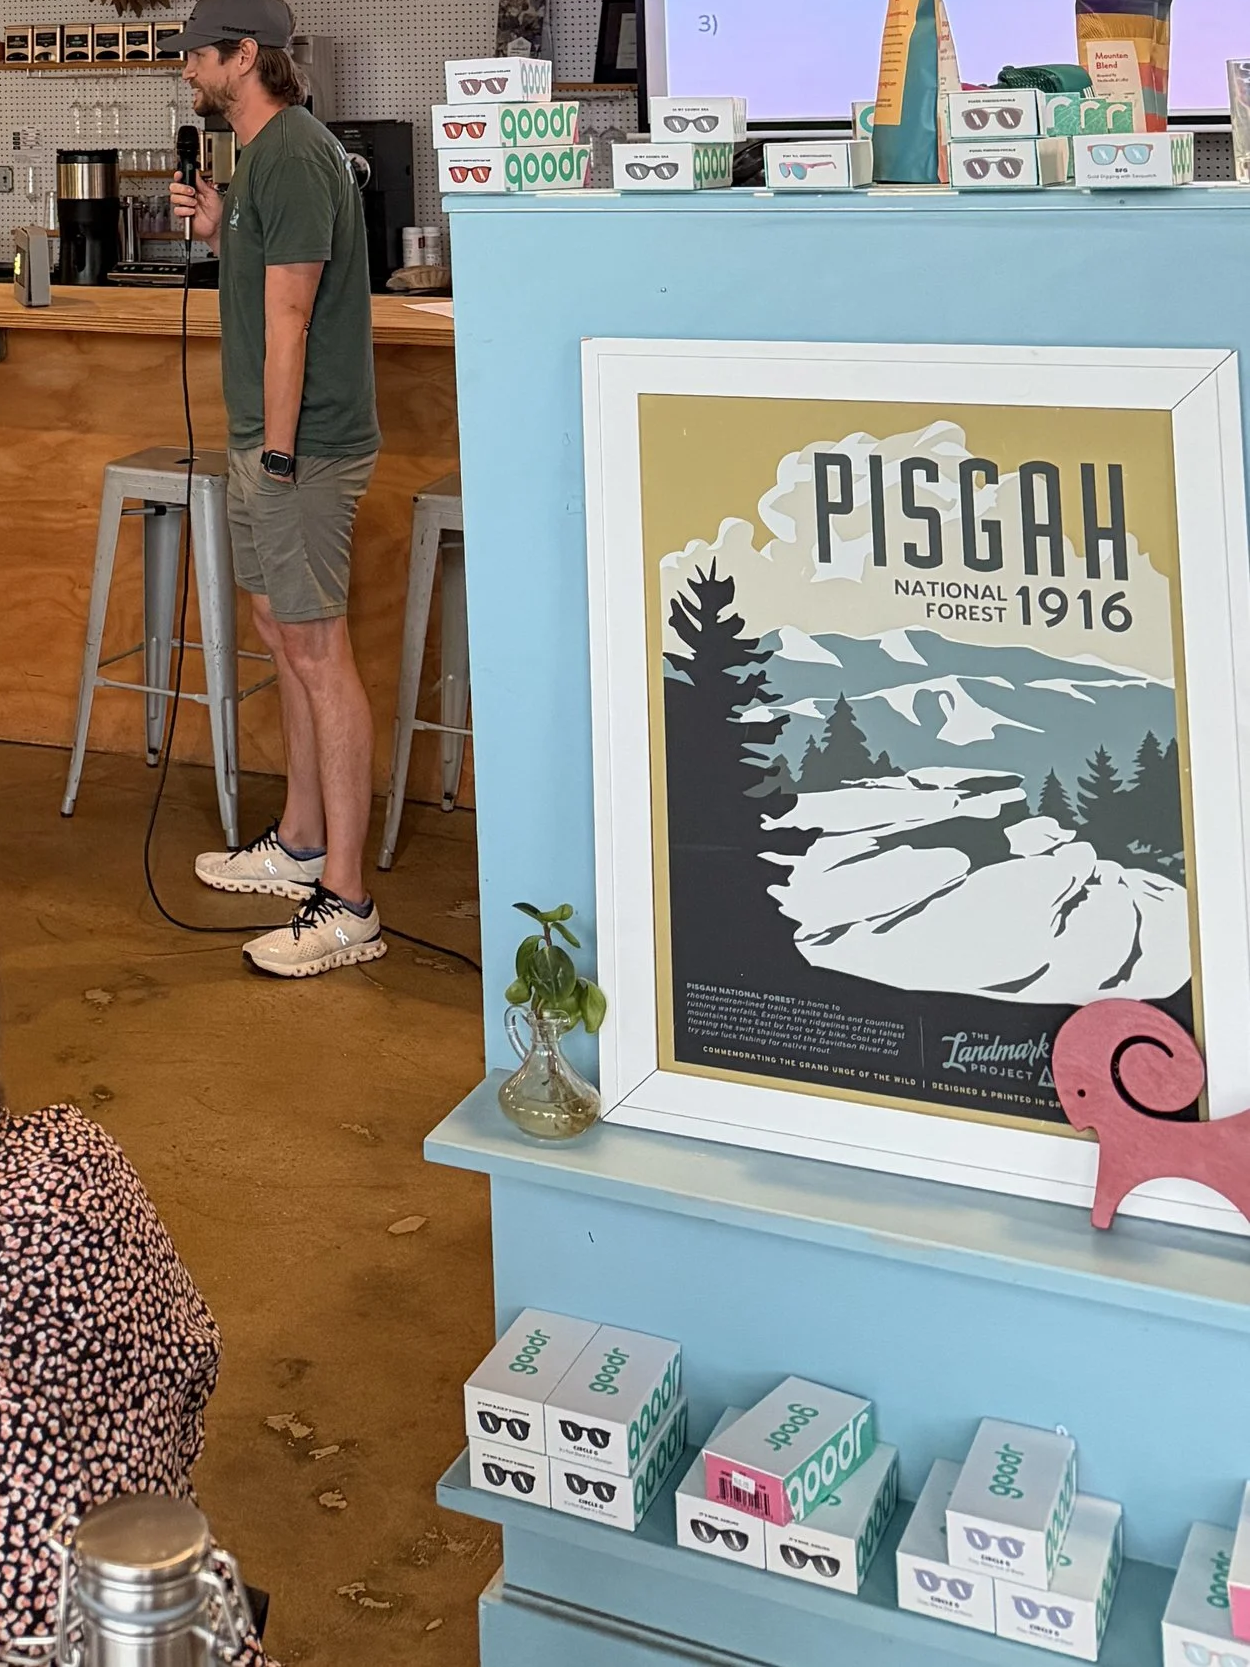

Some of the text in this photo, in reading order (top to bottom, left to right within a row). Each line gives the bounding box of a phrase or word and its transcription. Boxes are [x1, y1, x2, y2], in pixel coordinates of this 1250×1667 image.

[698, 13, 719, 36] 3)
[1095, 61, 1119, 70] Blend
[500, 103, 578, 147] goodr
[504, 147, 589, 191] goodr
[814, 452, 1130, 582] PISGAH
[894, 579, 1008, 602] NATIONAL
[926, 584, 1133, 634] FOREST 1916
[687, 982, 829, 1010] PISGAH NATIONAL FOREST home
[687, 1001, 716, 1012] rushing
[761, 1011, 792, 1022] Explore
[794, 1016, 807, 1024] the
[810, 1018, 850, 1031] ridgelines
[863, 1024, 877, 1034] the
[879, 1029, 905, 1040] tallest
[687, 1010, 728, 1021] mountains
[739, 1017, 752, 1025] the
[754, 1018, 772, 1027] East
[786, 1023, 803, 1032] foot
[851, 1034, 870, 1043] Cool
[872, 1036, 885, 1045] off
[688, 1017, 900, 1056] floating the swift shallows the Davidson River and
[792, 1008, 821, 1018] granite
[823, 1011, 846, 1022] balds
[848, 1016, 863, 1024] and
[865, 1018, 905, 1030] countless
[972, 1031, 989, 1040] THE
[720, 1031, 737, 1039] luck
[739, 1033, 767, 1045] fishing
[783, 1040, 807, 1051] native
[941, 1031, 1050, 1073] Landmark
[703, 1045, 777, 1064] COMMEMORATING
[779, 1057, 797, 1067] THE
[799, 1061, 829, 1072] GRAND
[832, 1066, 855, 1077] URGE
[859, 1070, 871, 1079] OF
[874, 1072, 890, 1082] THE
[894, 1076, 916, 1086] WILD
[932, 1082, 978, 1095] DESIGNED
[990, 1091, 1031, 1104] PRINTED
[971, 1063, 1033, 1081] PROJECT
[509, 1329, 551, 1375] goodr
[588, 1347, 630, 1395] goodr
[628, 1352, 681, 1464] goodr
[765, 1403, 819, 1451] goodr
[784, 1412, 869, 1522] goodr
[988, 1443, 1025, 1499] goodr
